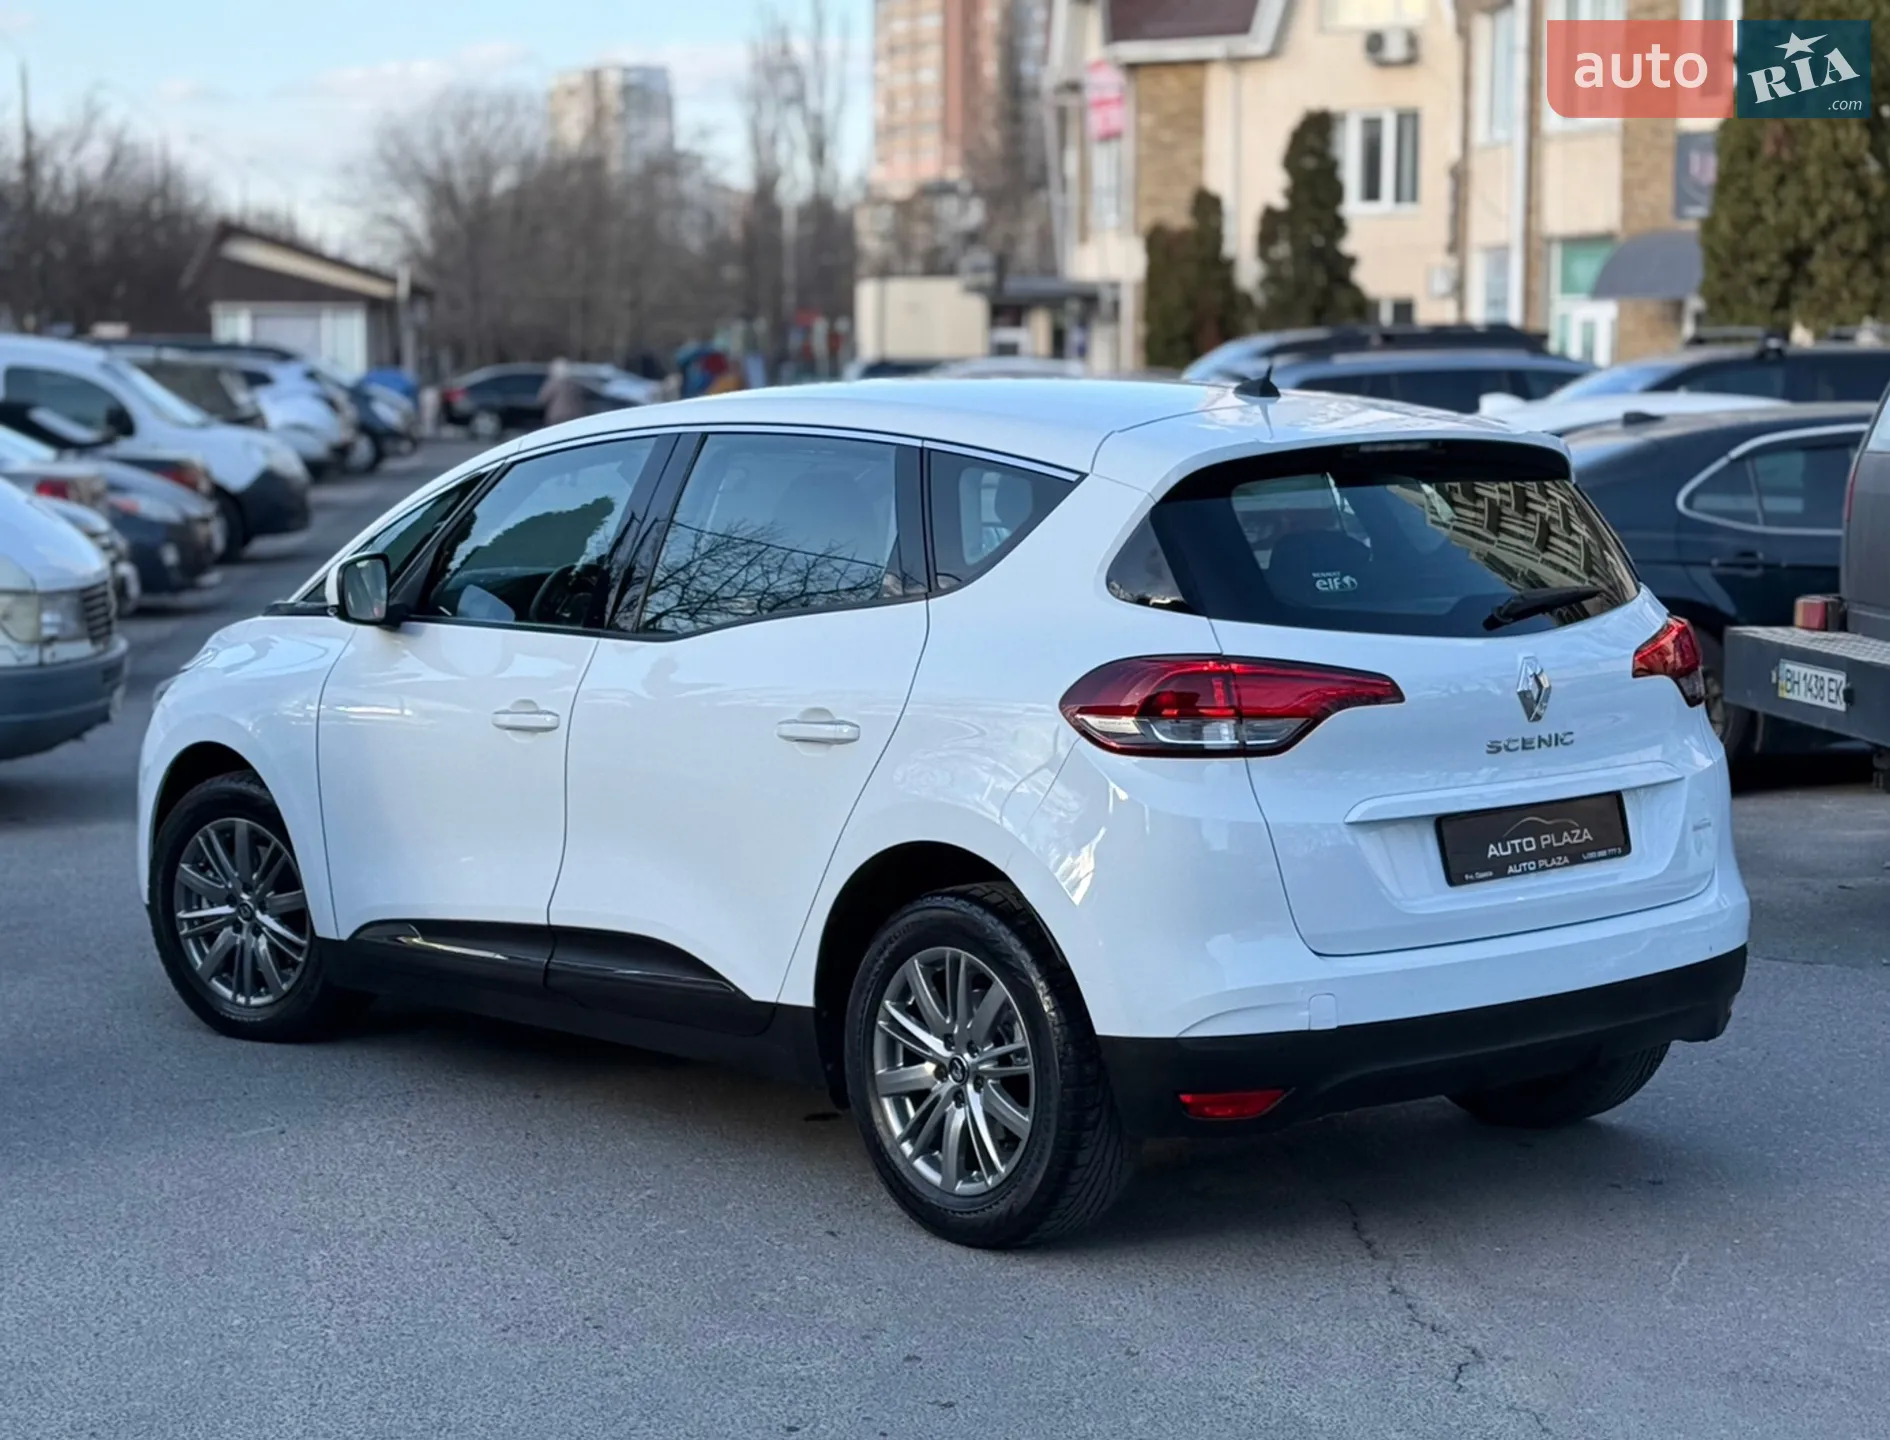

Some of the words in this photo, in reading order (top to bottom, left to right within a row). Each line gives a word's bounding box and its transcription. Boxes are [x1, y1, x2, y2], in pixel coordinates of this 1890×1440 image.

[1827, 677, 1844, 706] EK
[1485, 731, 1575, 755] SCENIC
[1487, 837, 1537, 859] AUTO
[1540, 828, 1593, 849] PLAZA
[1507, 861, 1537, 875] AUTO
[1538, 856, 1570, 868] PLAZA
